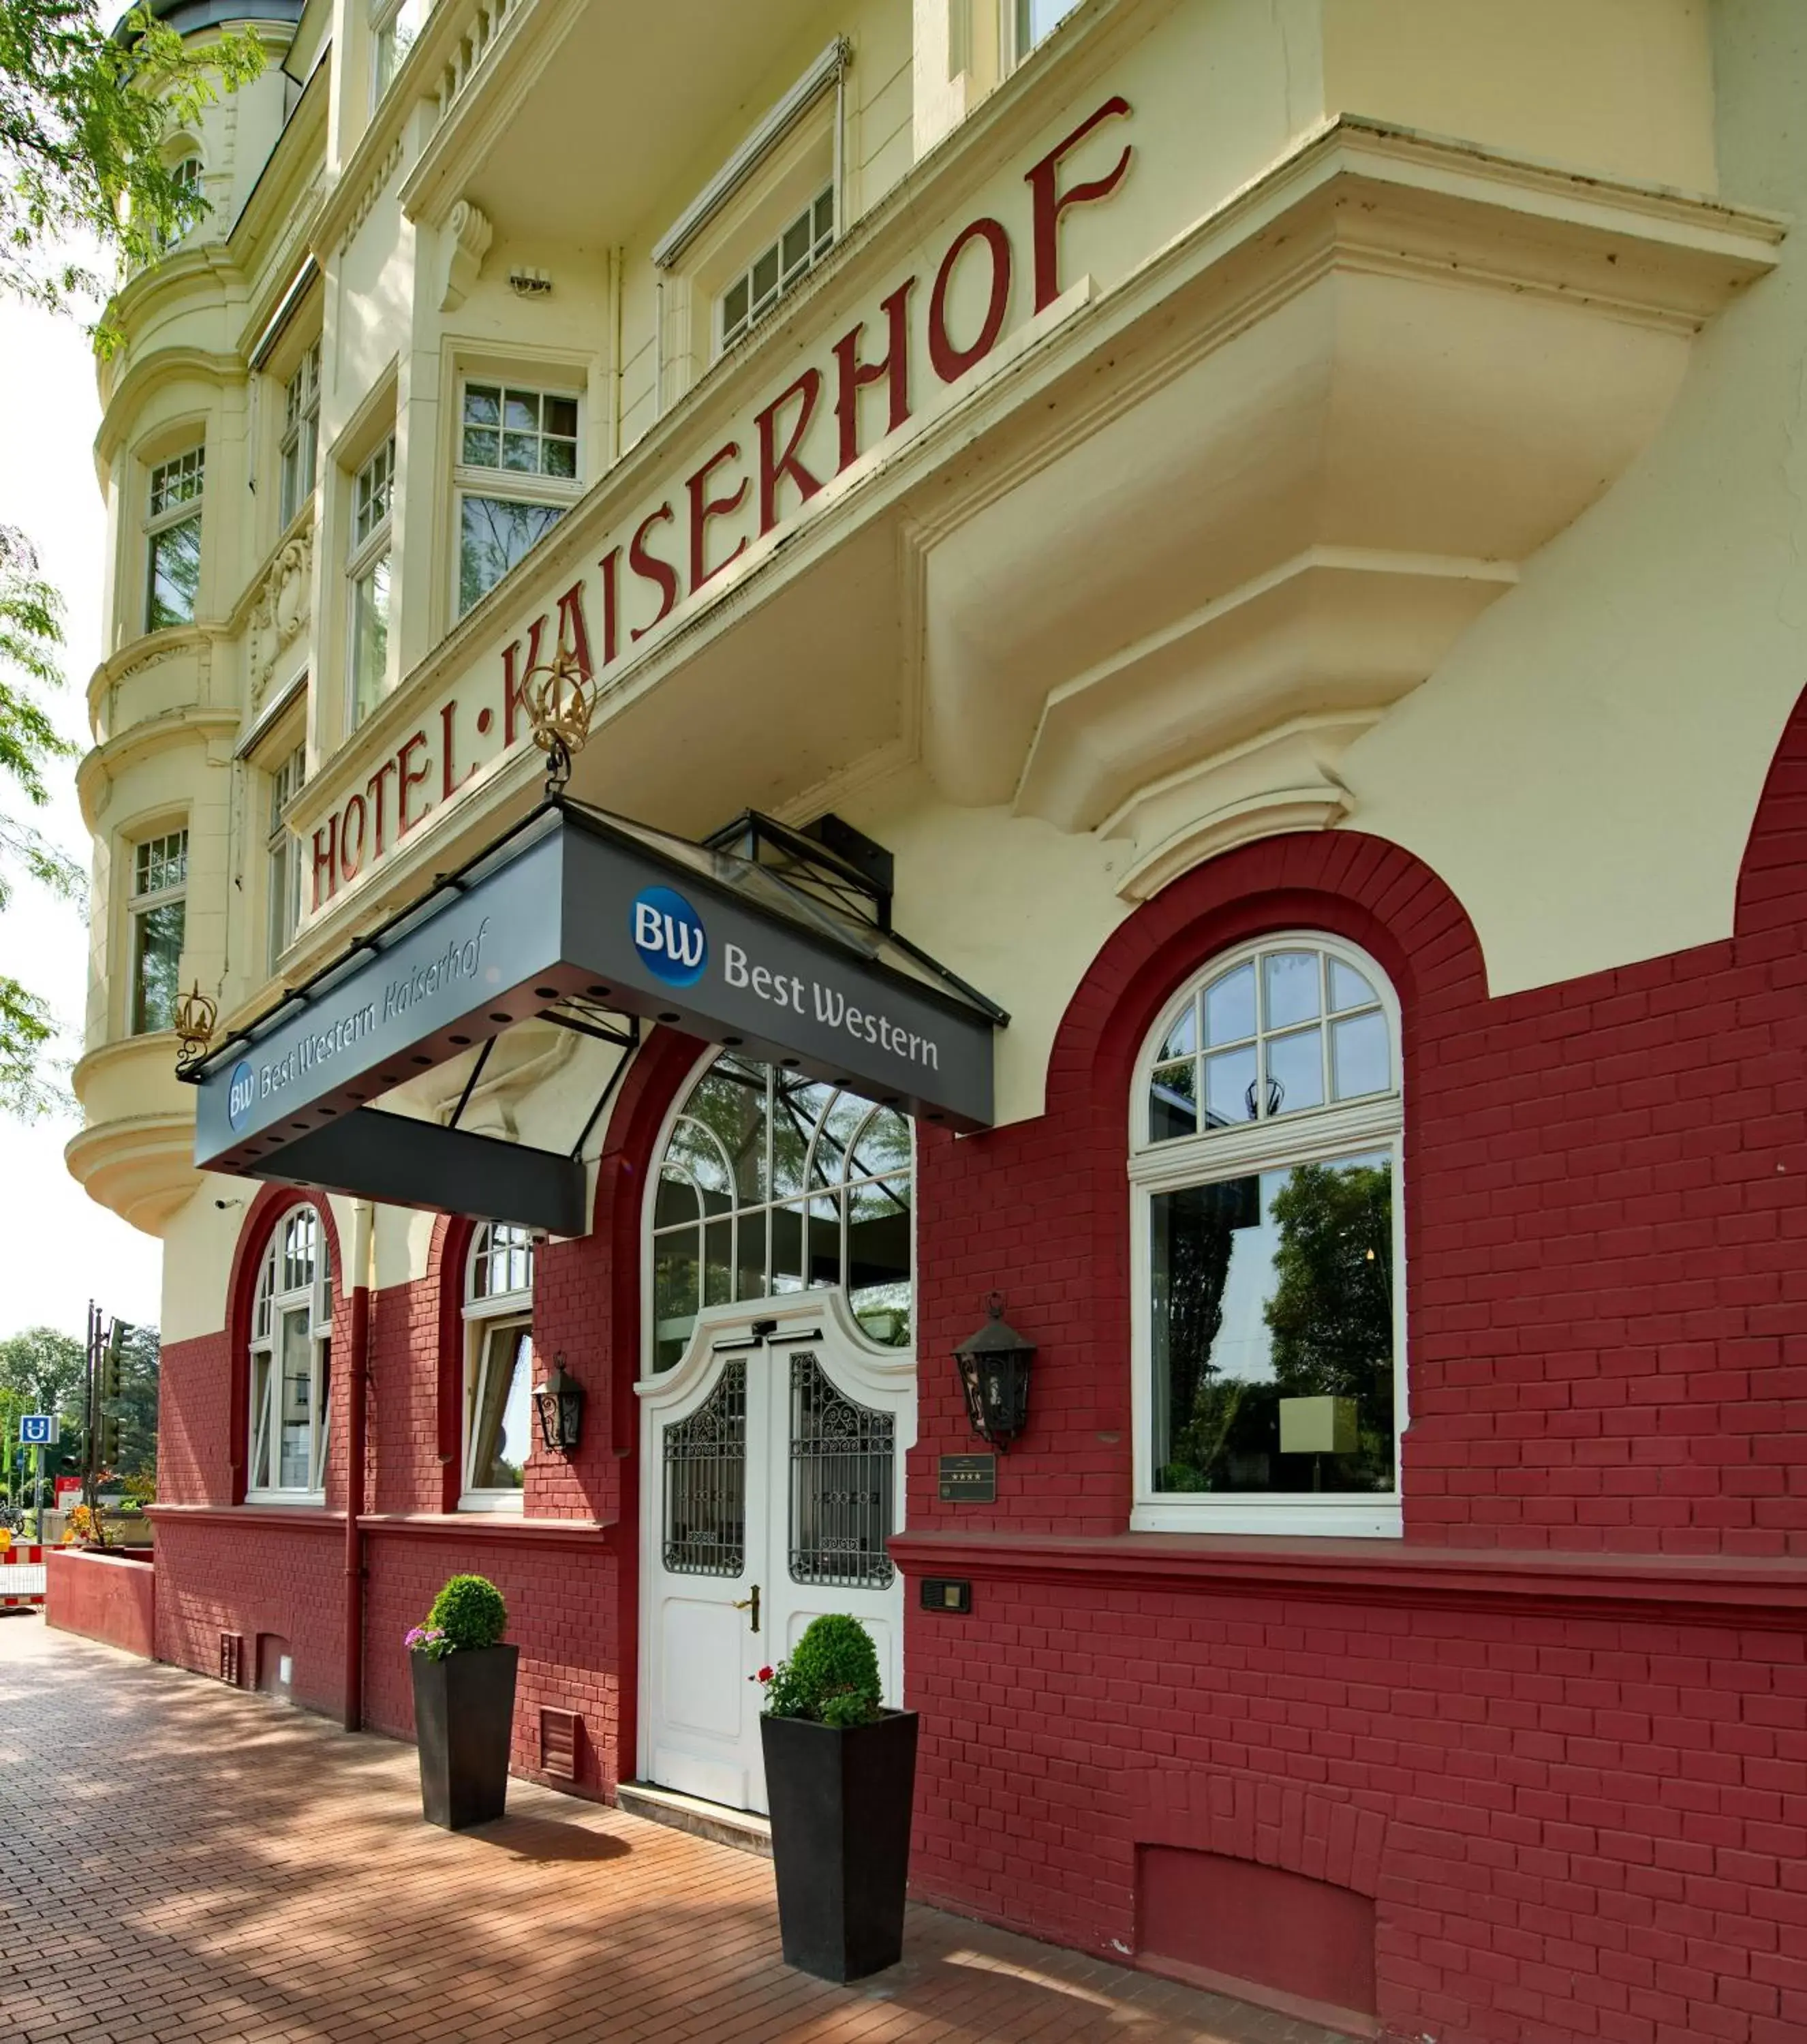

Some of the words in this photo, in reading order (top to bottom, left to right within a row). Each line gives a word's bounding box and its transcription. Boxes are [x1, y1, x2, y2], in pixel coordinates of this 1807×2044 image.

[311, 698, 480, 915] HOTEL
[501, 95, 1132, 749] KAISERHOF
[635, 901, 704, 967] BW
[259, 1050, 296, 1100] Best
[297, 1002, 377, 1077] Western
[382, 916, 491, 1023] Kaiserhof
[724, 942, 805, 1015] Best
[812, 981, 940, 1072] Western
[229, 1073, 254, 1119] BW
